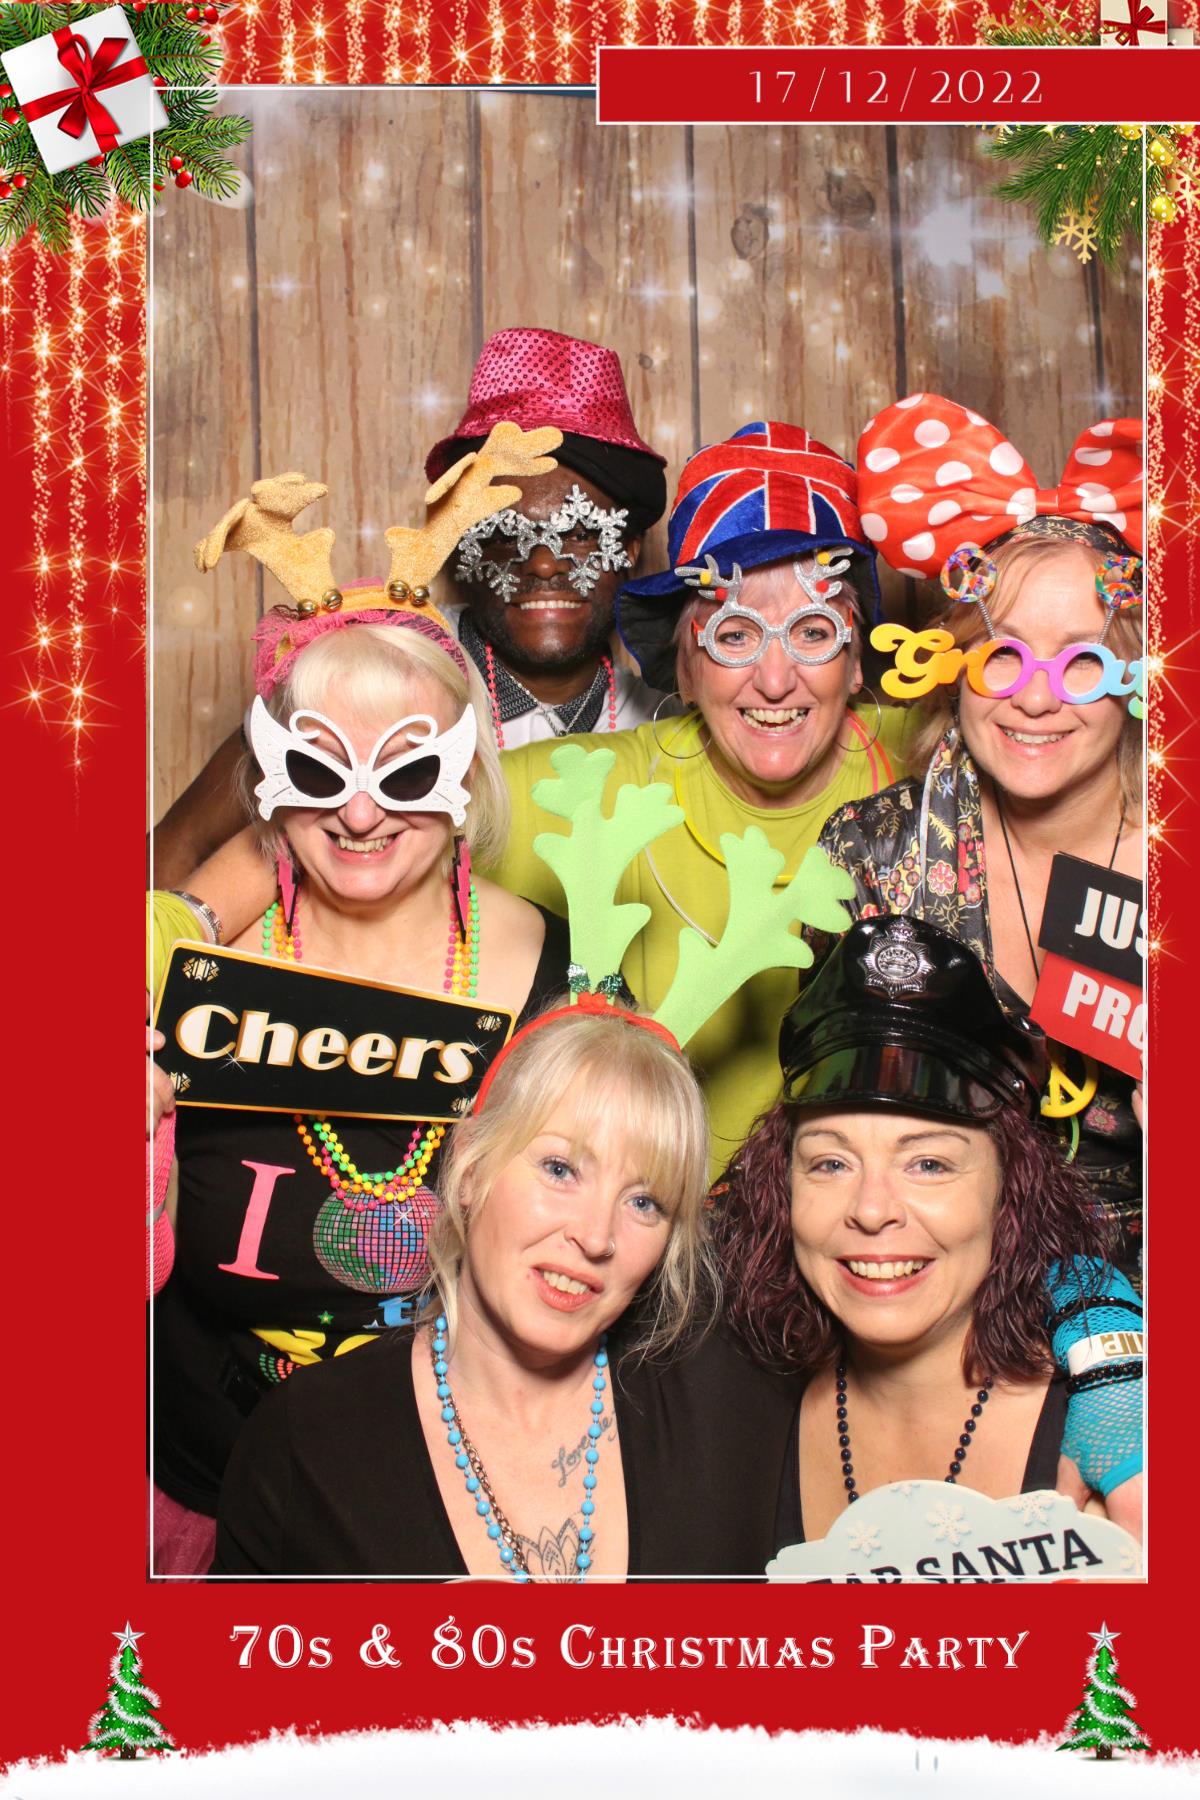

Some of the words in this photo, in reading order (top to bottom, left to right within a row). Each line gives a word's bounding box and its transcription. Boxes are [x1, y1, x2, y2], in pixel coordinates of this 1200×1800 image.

[1074, 886, 1148, 959] JU
[174, 1003, 479, 1084] Cheers
[217, 1159, 296, 1280] I
[915, 1527, 1104, 1584] SANTA
